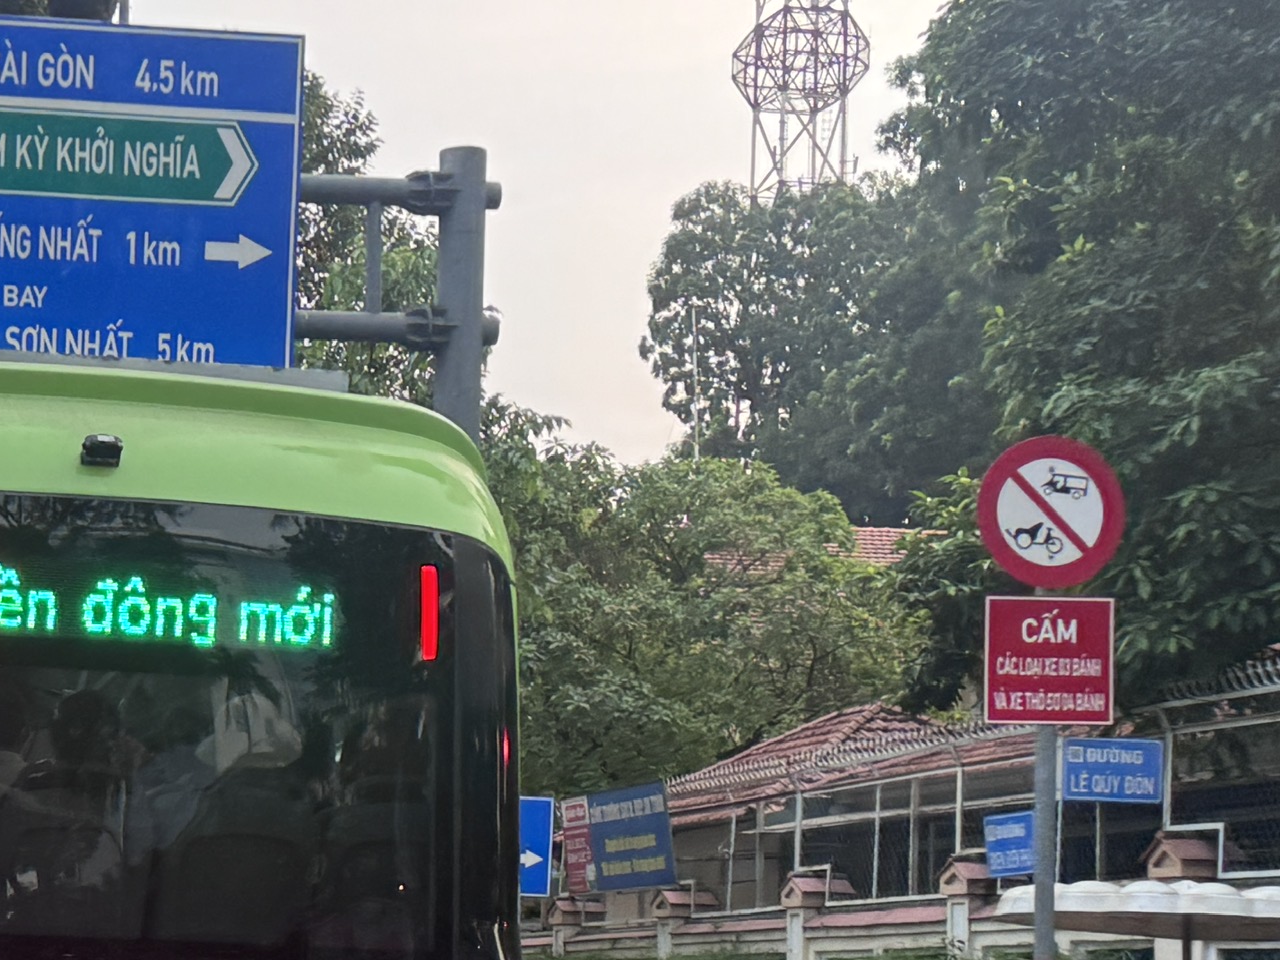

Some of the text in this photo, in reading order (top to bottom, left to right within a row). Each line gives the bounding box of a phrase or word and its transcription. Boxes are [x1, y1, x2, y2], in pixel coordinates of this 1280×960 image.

[37, 43, 94, 89] GÒN
[181, 61, 219, 97] km
[16, 125, 49, 170] KỲ
[56, 126, 114, 174] KHỞI
[123, 135, 201, 179] NGHĨA
[38, 214, 103, 262] NHẤT
[126, 231, 136, 265] 1
[143, 231, 181, 266] km
[3, 284, 48, 308] BAY
[5, 324, 57, 355] SƠN
[65, 319, 133, 358] NHẤT
[158, 333, 171, 362] 5
[177, 333, 215, 363] km
[83, 576, 217, 648] đông
[239, 585, 335, 647] mới
[1022, 609, 1077, 643] CẤM
[996, 651, 1018, 675] CÁC
[1043, 657, 1058, 676] XE
